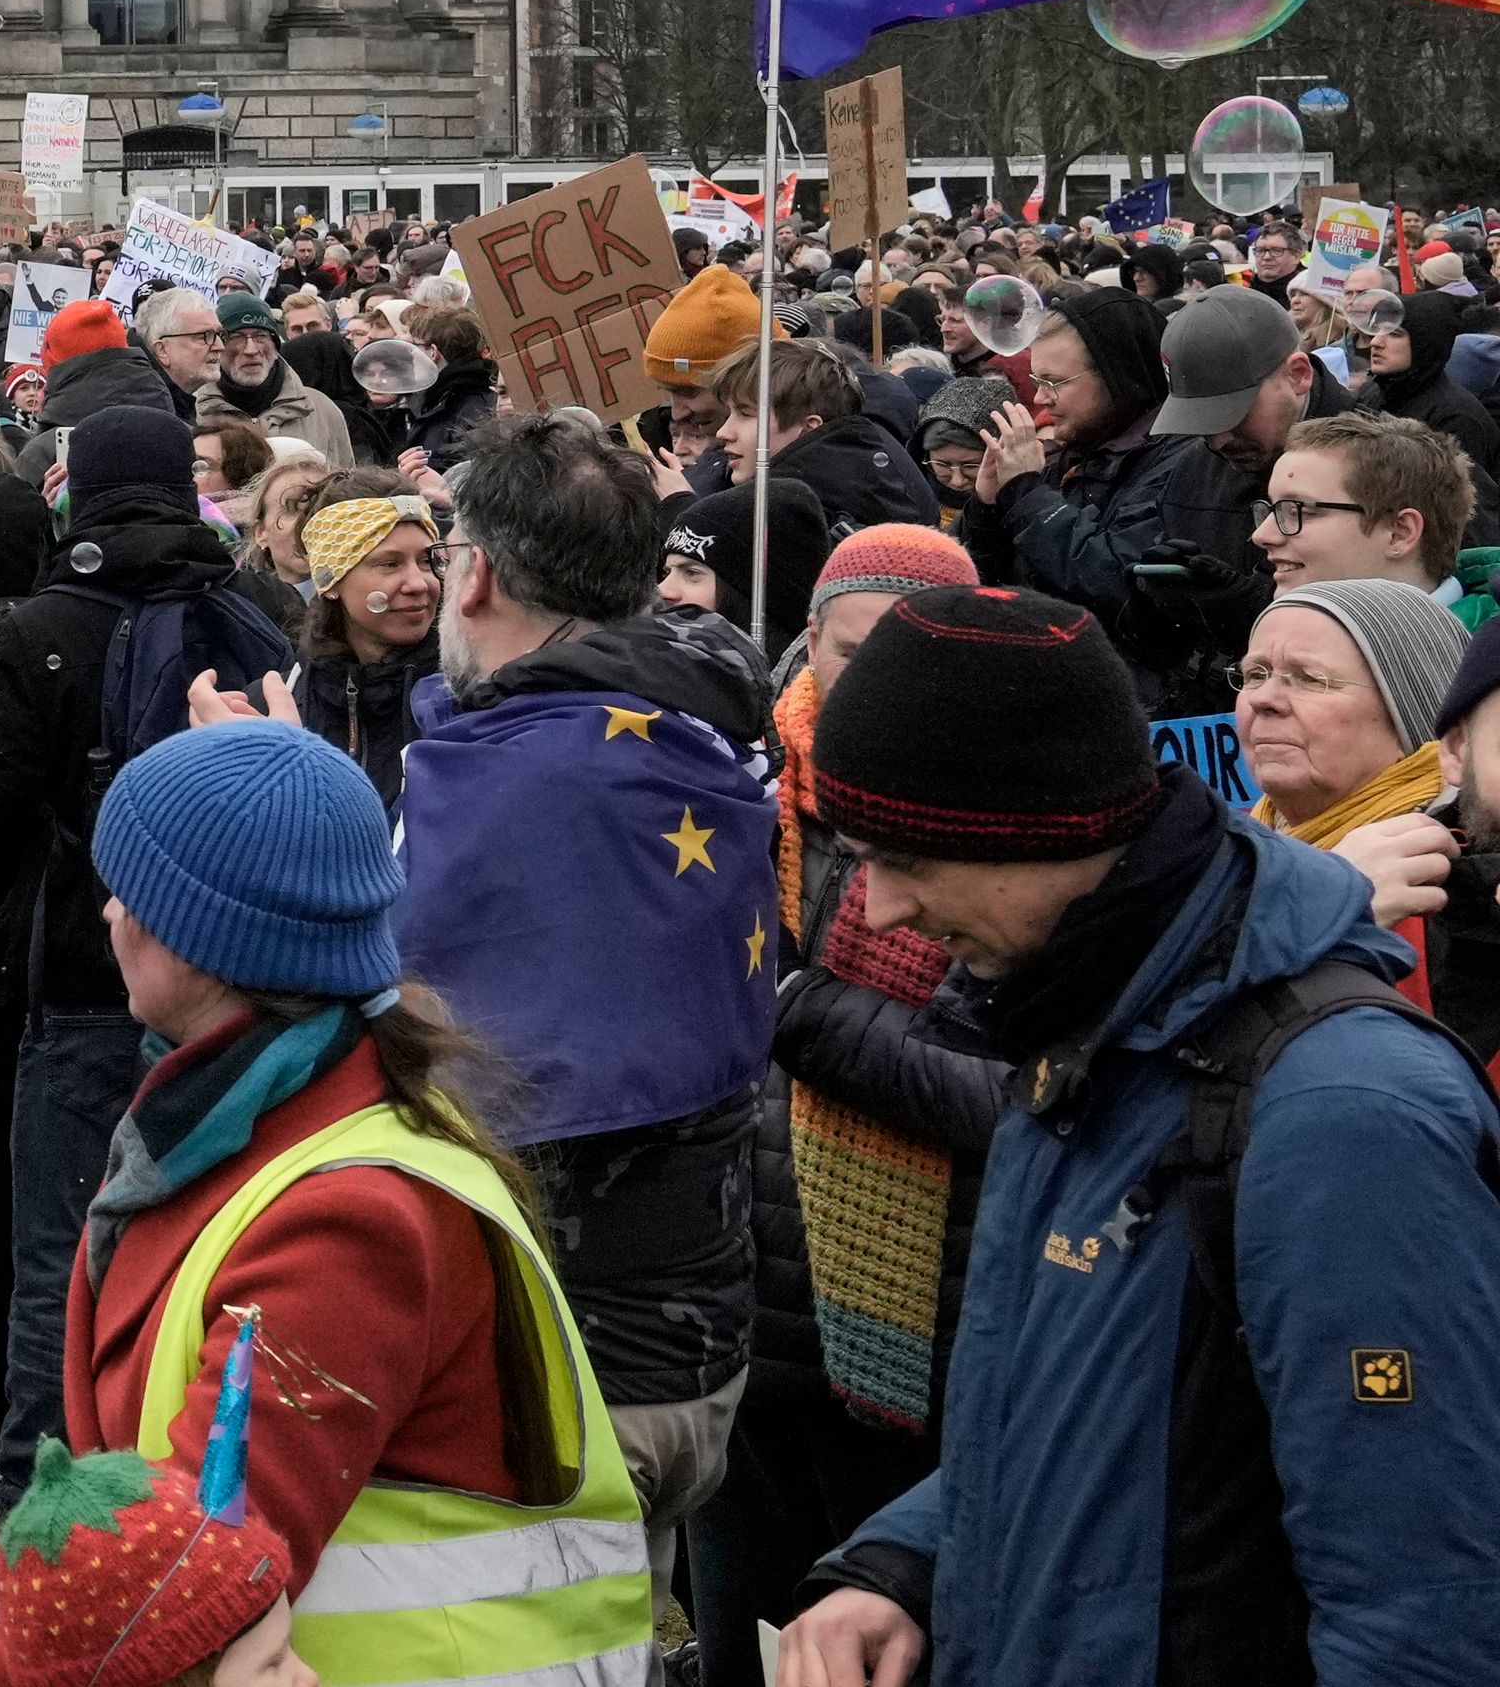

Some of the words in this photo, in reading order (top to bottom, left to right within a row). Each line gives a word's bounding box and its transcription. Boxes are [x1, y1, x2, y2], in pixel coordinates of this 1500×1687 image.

[1329, 222, 1346, 234] ZUR
[1347, 226, 1370, 239] HETZE
[1331, 234, 1357, 247] GEGEN
[478, 185, 651, 319] FCK
[1325, 243, 1363, 258] MUSLIME
[14, 310, 32, 325] NIE
